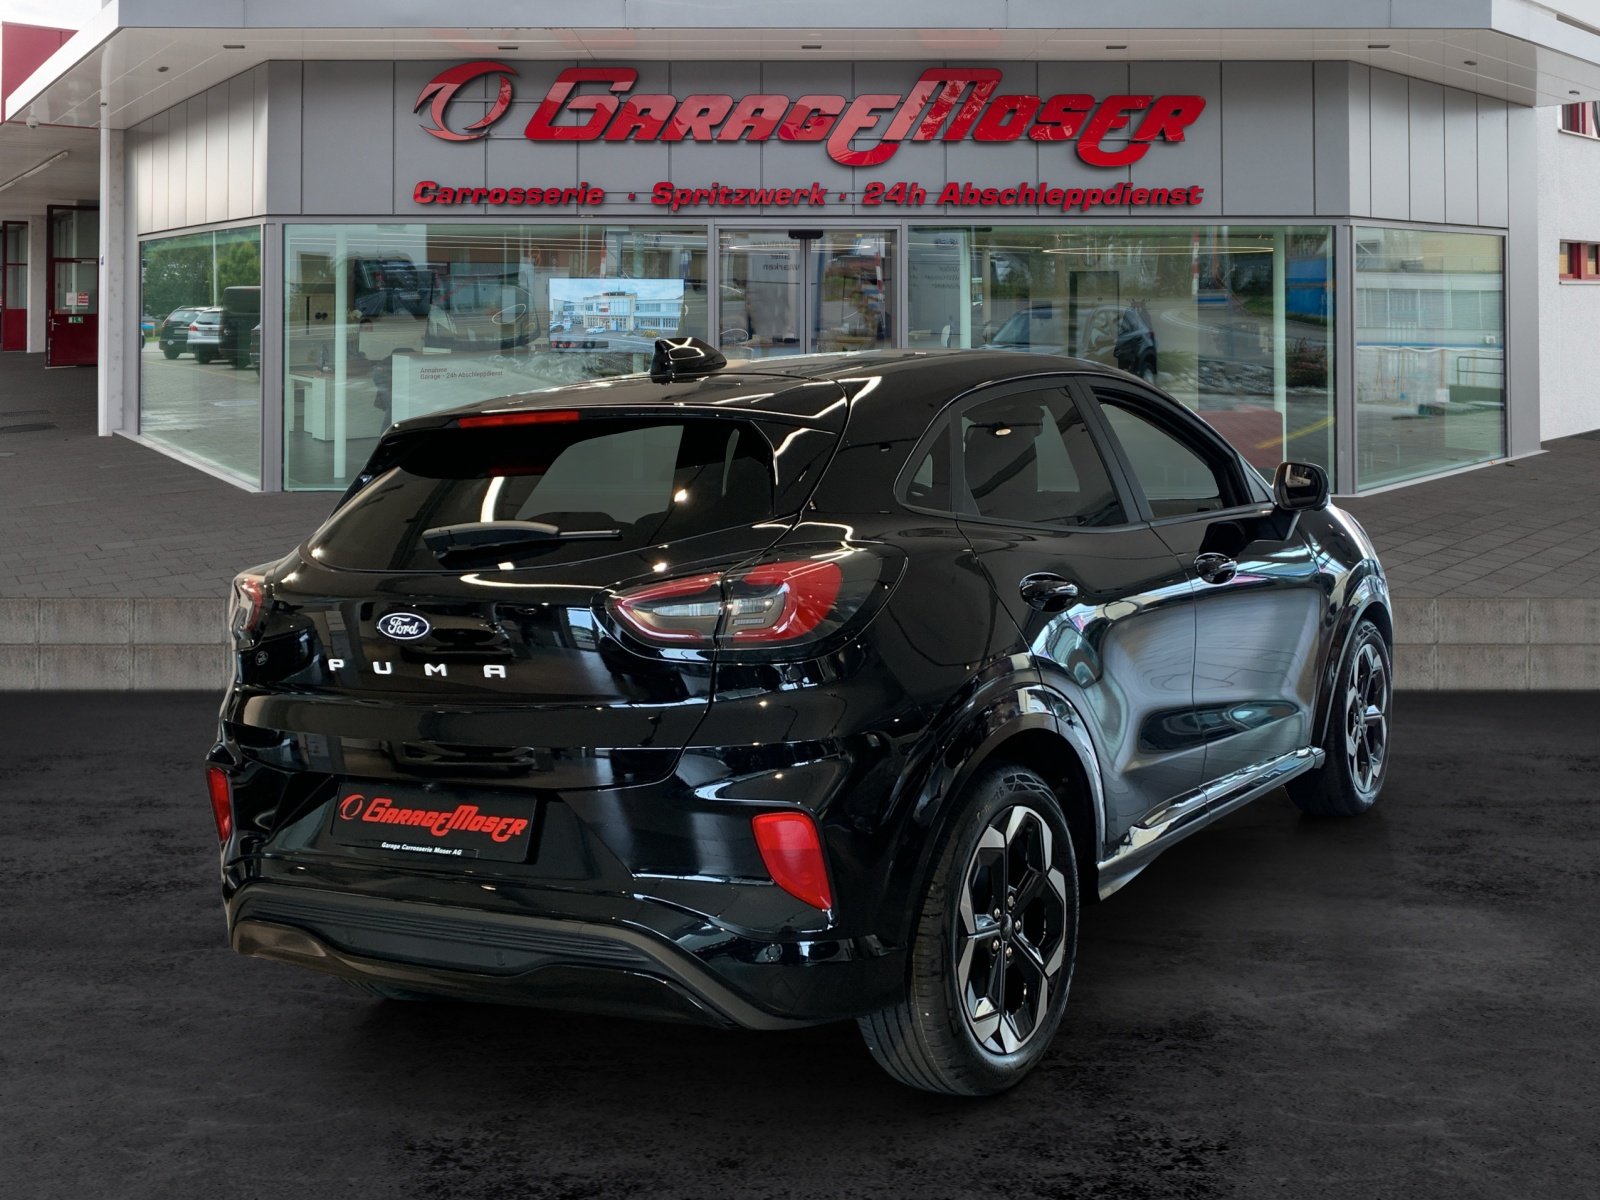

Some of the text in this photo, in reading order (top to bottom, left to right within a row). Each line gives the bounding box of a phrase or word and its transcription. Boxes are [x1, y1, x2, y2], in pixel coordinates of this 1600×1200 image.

[413, 181, 1204, 211] Carrosserie Spritzwerk 24h Abschleppdienst
[387, 616, 420, 635] Ford
[328, 658, 507, 679] PUMA
[381, 841, 401, 851] Garage
[401, 844, 433, 853] Carrosserie
[433, 846, 452, 855] Moser
